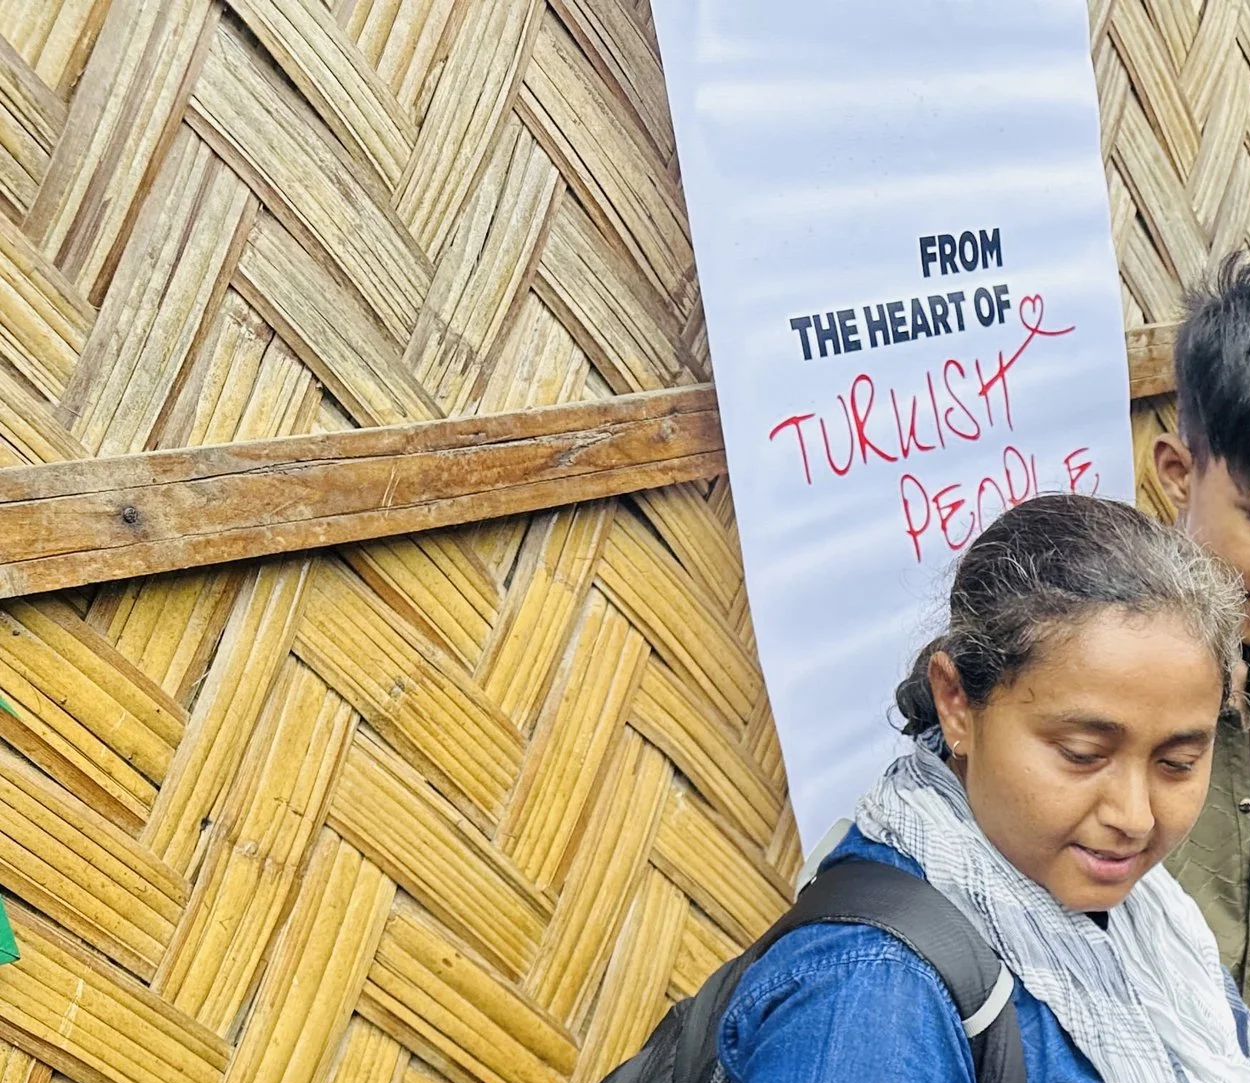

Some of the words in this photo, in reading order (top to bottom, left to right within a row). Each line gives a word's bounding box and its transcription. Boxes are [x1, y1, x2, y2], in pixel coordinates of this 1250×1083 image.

[919, 228, 1003, 277] FROM
[790, 309, 862, 361] THE
[863, 291, 967, 346] HEART
[974, 284, 1011, 327] OF
[769, 351, 1014, 485] TURKISH
